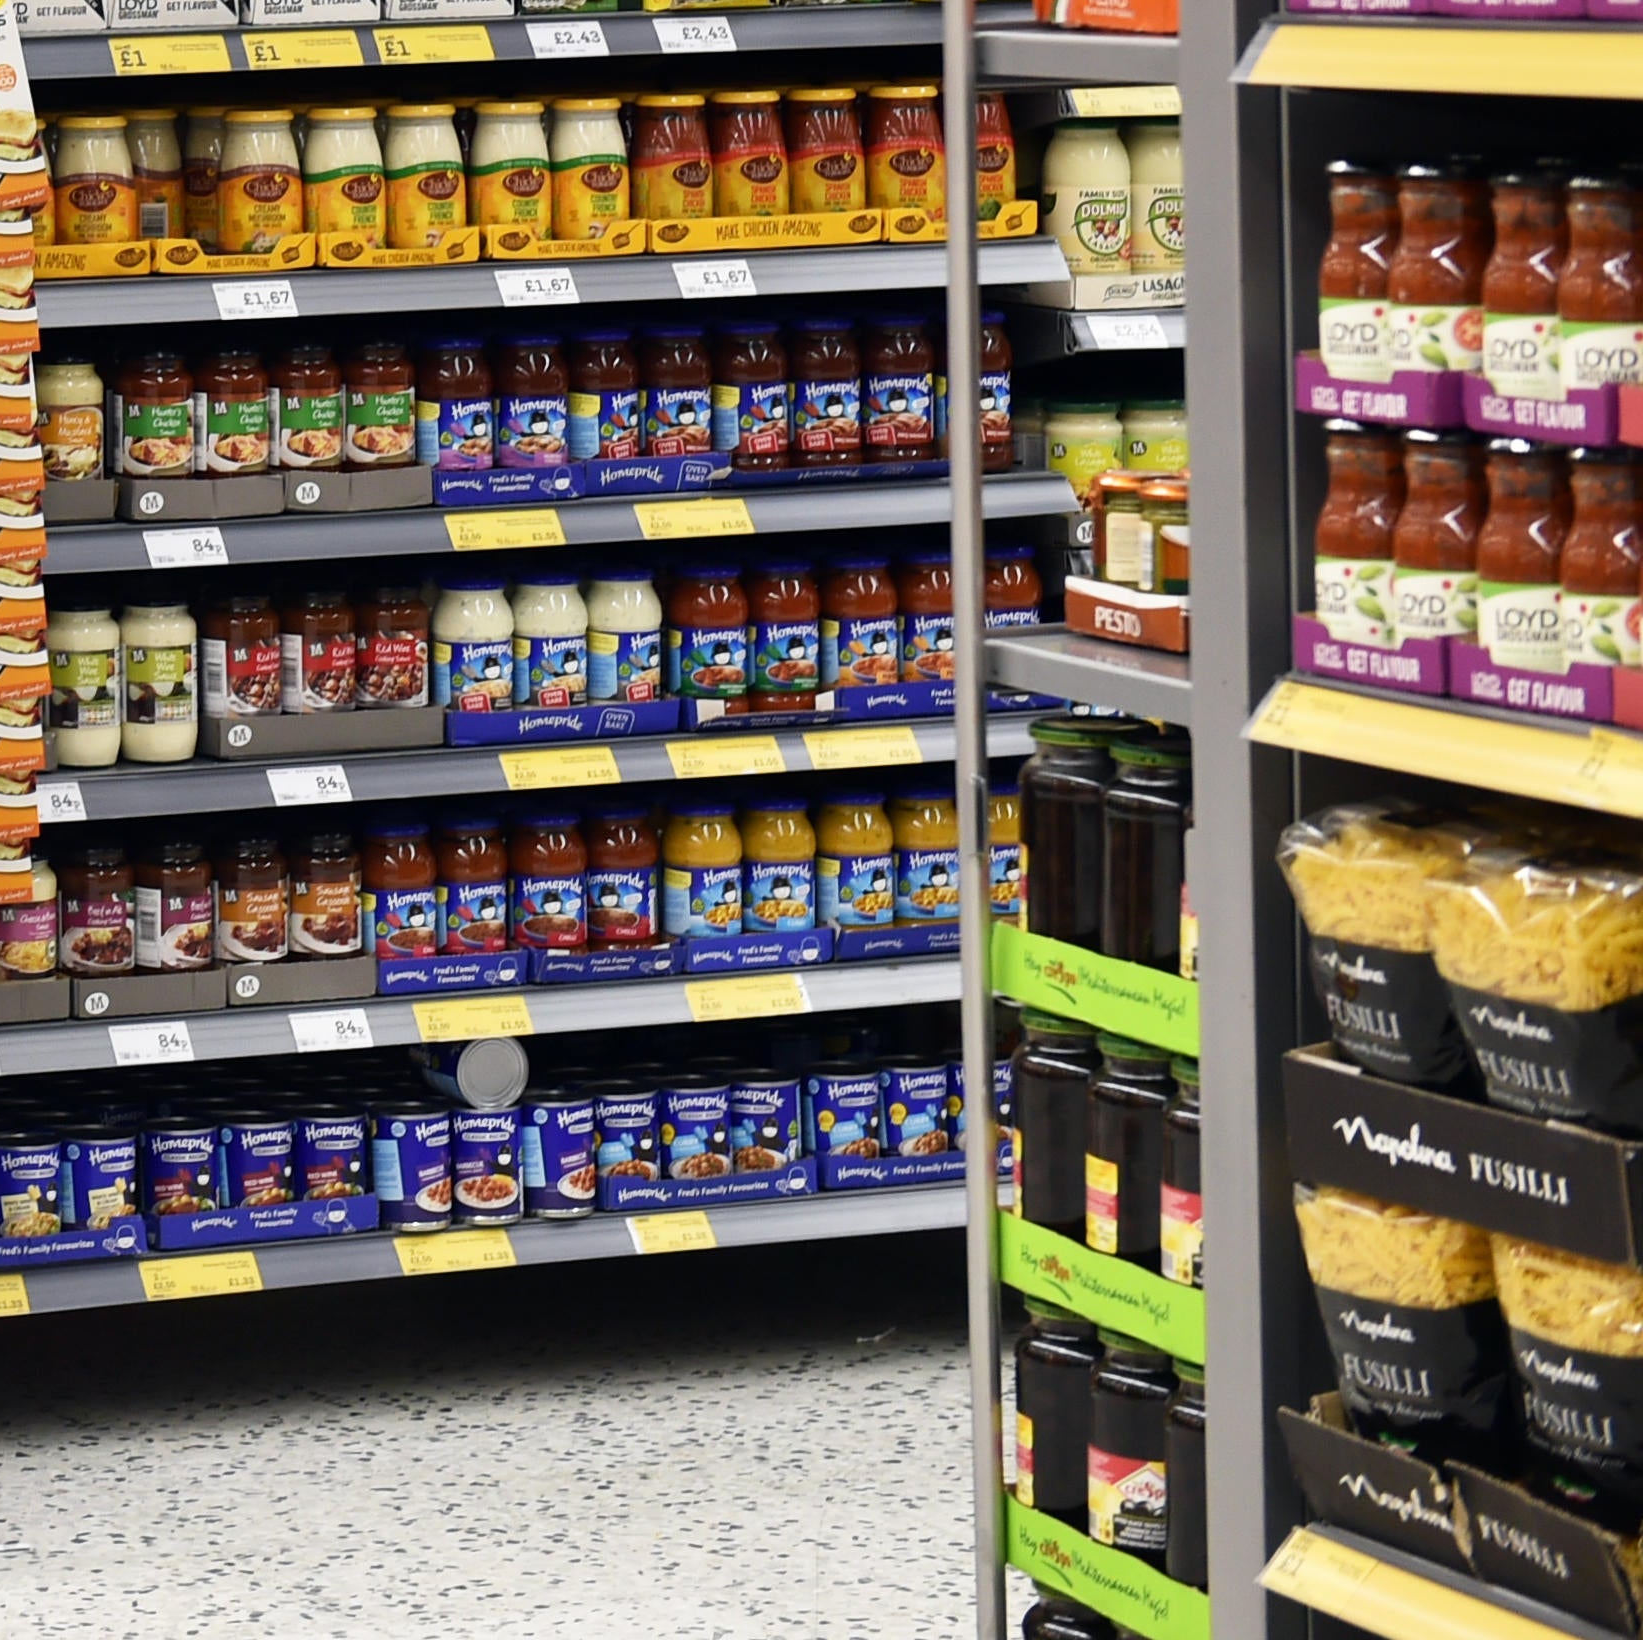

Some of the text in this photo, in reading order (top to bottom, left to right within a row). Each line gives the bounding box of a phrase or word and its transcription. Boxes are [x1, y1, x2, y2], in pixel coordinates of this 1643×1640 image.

[167, 0, 181, 11] GET
[183, 0, 217, 11] FLAVOUR
[555, 31, 600, 44] £2.43
[683, 26, 728, 39] £2.43
[255, 45, 281, 61] £1
[385, 40, 411, 56] £1
[121, 50, 146, 67] £1
[1082, 204, 1125, 216] DOLMIO
[716, 221, 821, 240] MAKE CHICKEN AMAZING
[703, 271, 748, 285] £1.67
[243, 290, 289, 306] £1.67
[600, 465, 664, 484] Homepride
[192, 536, 223, 555] 84p
[1095, 606, 1141, 637] PESTO
[1496, 608, 1558, 628] LOYD
[518, 714, 583, 733] Homepride
[317, 774, 346, 791] 84p
[51, 792, 81, 811] 84p
[1326, 993, 1399, 1041] FUSILLI
[336, 1019, 364, 1038] 84p
[158, 1032, 188, 1049] 84p
[1469, 1152, 1569, 1206] FUSILLI
[1342, 1353, 1430, 1398] FUSILLI
